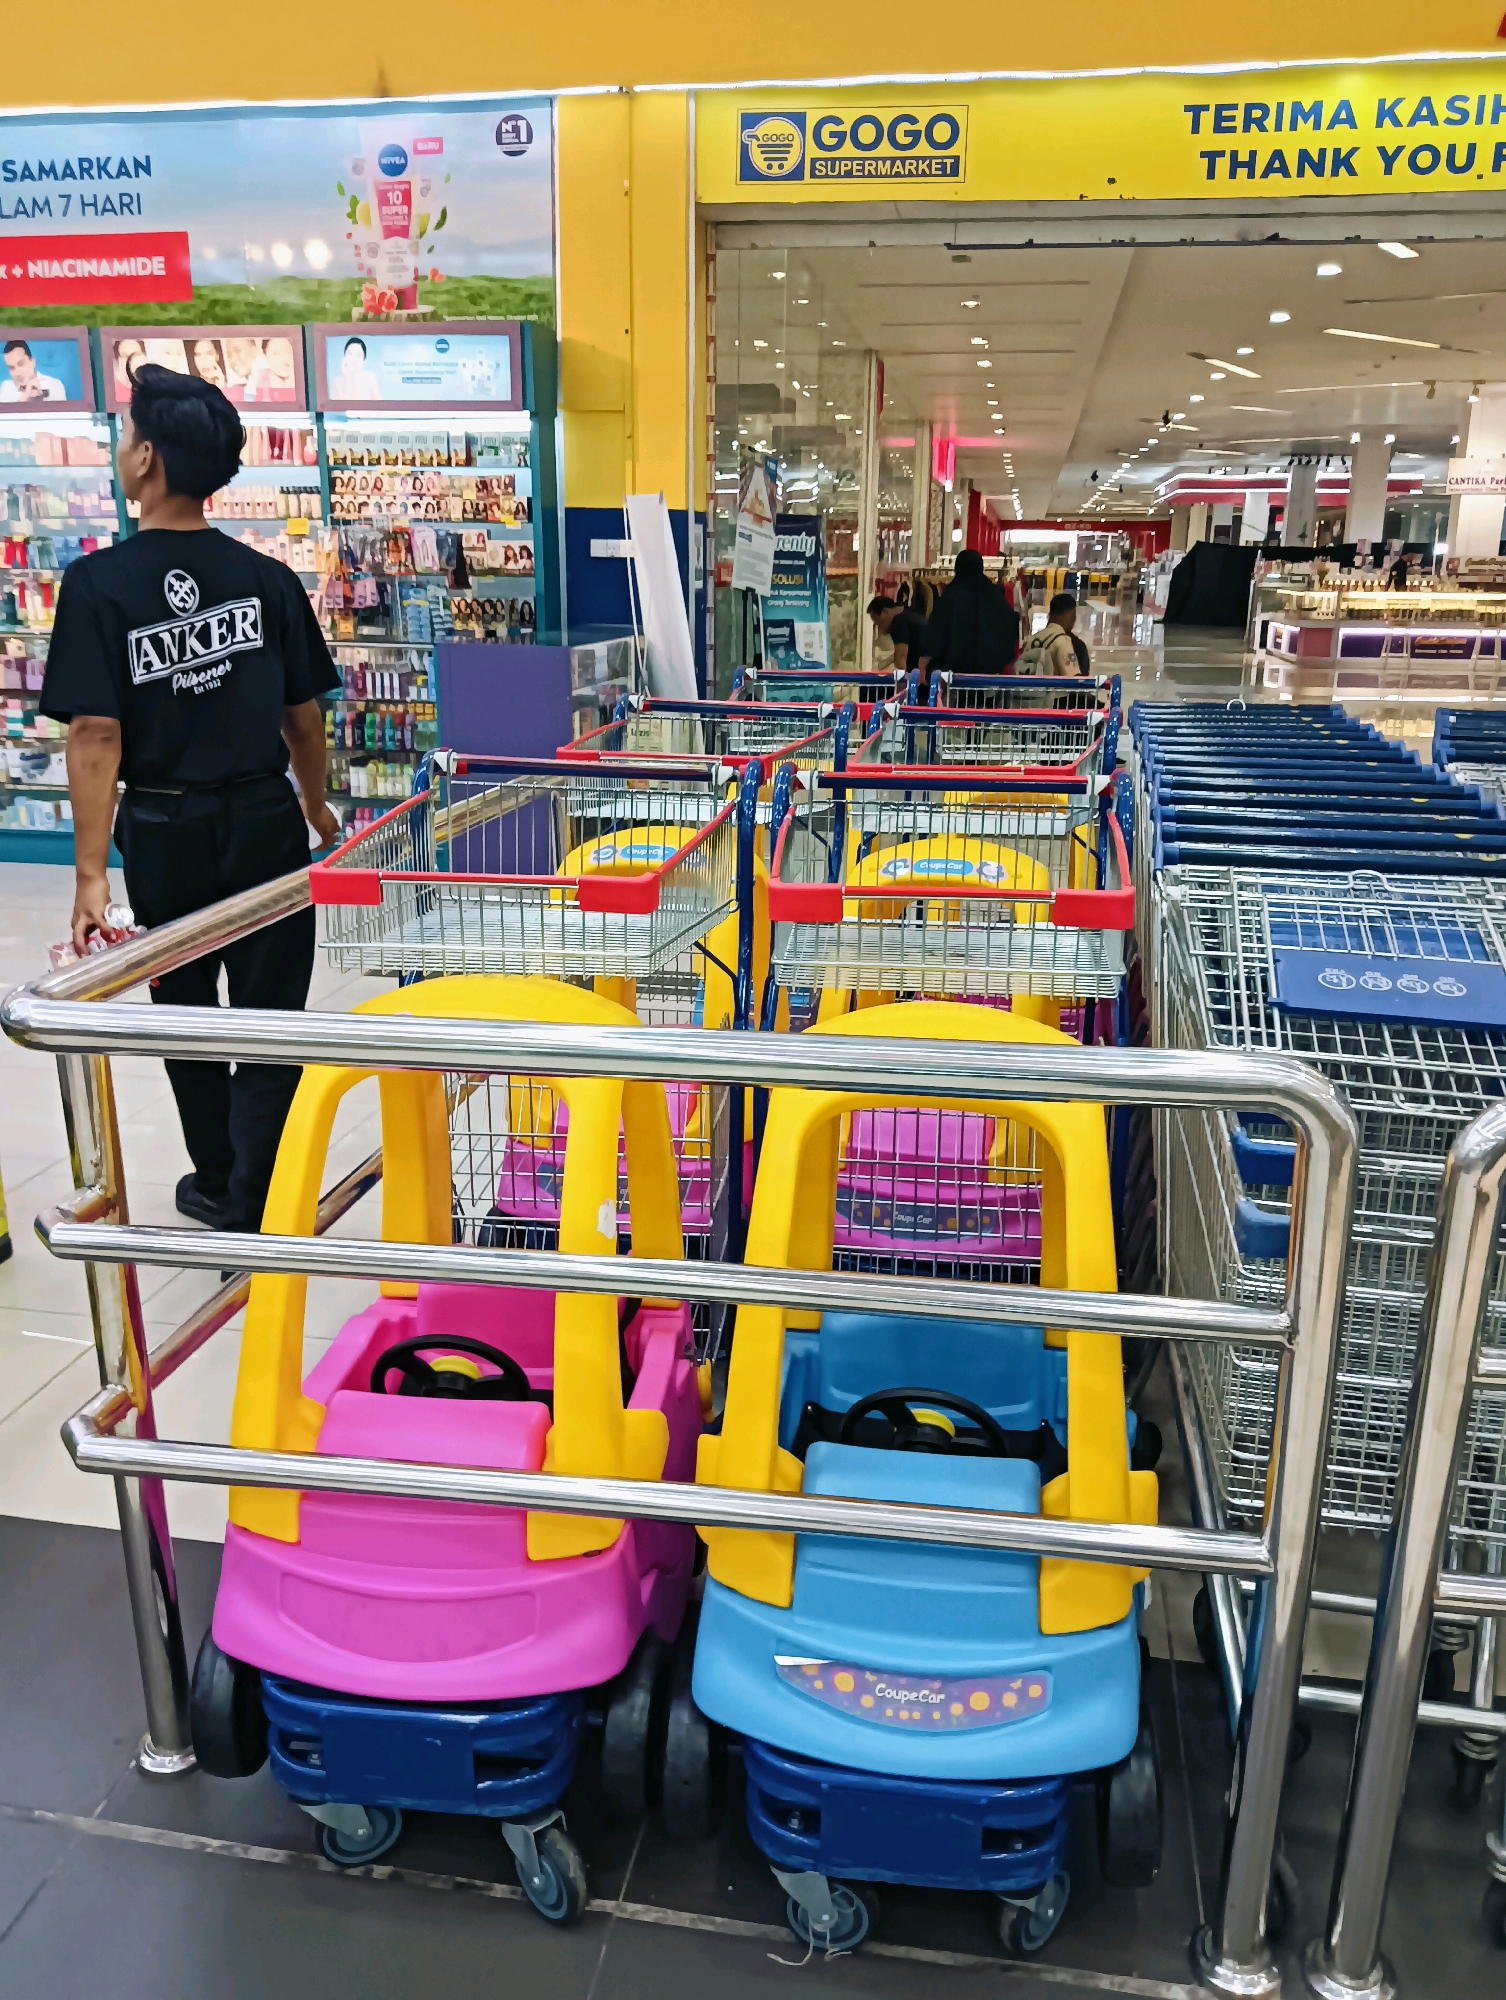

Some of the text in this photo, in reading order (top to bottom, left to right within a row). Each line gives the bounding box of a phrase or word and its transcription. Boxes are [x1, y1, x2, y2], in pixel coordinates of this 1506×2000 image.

[1184, 99, 1358, 134] TERIMA
[762, 133, 794, 142] GOGO
[812, 113, 960, 152] GOGO
[2, 155, 152, 182] SAMARKAN
[380, 156, 405, 165] NIVEA
[814, 159, 954, 176] SUPERMARKET
[1199, 147, 1360, 180] THANK
[1376, 142, 1477, 175] YOU
[58, 194, 72, 217] 7
[80, 192, 142, 217] HARI
[387, 190, 403, 205] 10
[27, 256, 166, 279] NIACINAMIDE
[1449, 477, 1486, 485] CANTIKA
[138, 607, 260, 675] ANKER
[172, 659, 232, 695] Pilsener
[874, 1683, 945, 1704] CoupeCar
